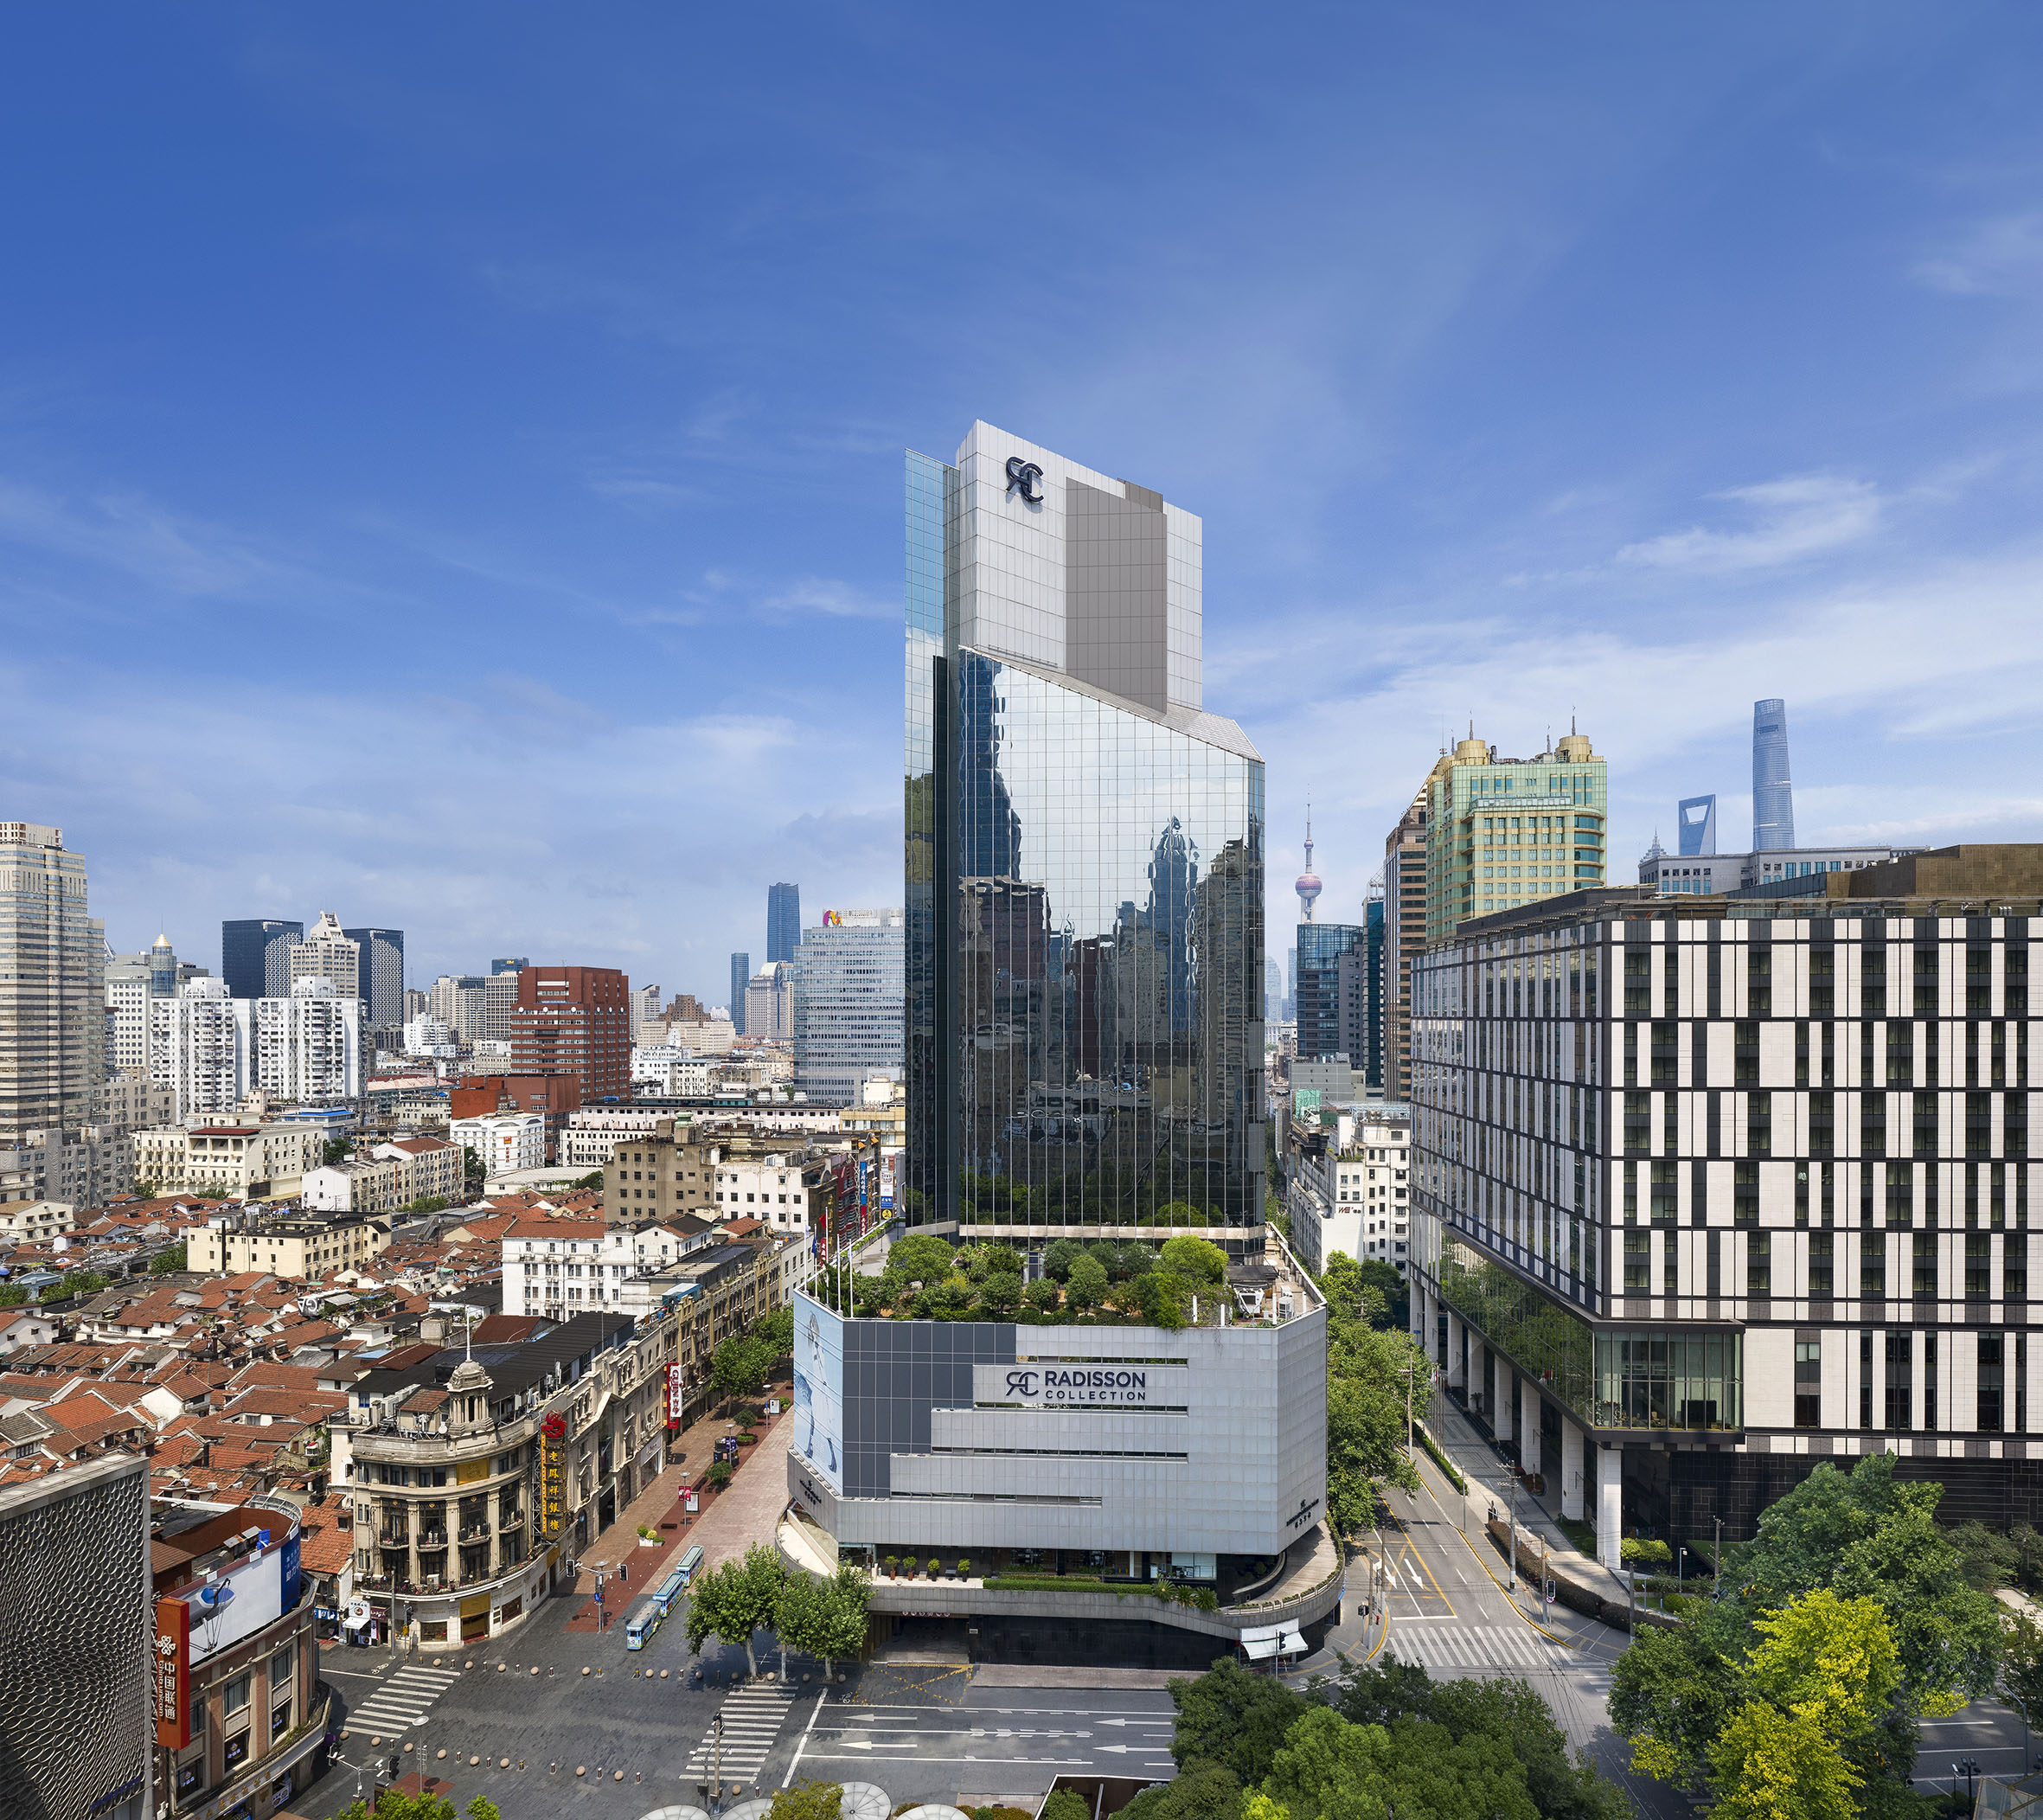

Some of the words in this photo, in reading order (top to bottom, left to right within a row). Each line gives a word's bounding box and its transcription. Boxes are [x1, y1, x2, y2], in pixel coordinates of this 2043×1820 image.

[1045, 1370, 1146, 1387] RADISSON
[1046, 1390, 1146, 1400] COLLECTION
[164, 1661, 176, 1720] 中国联通
